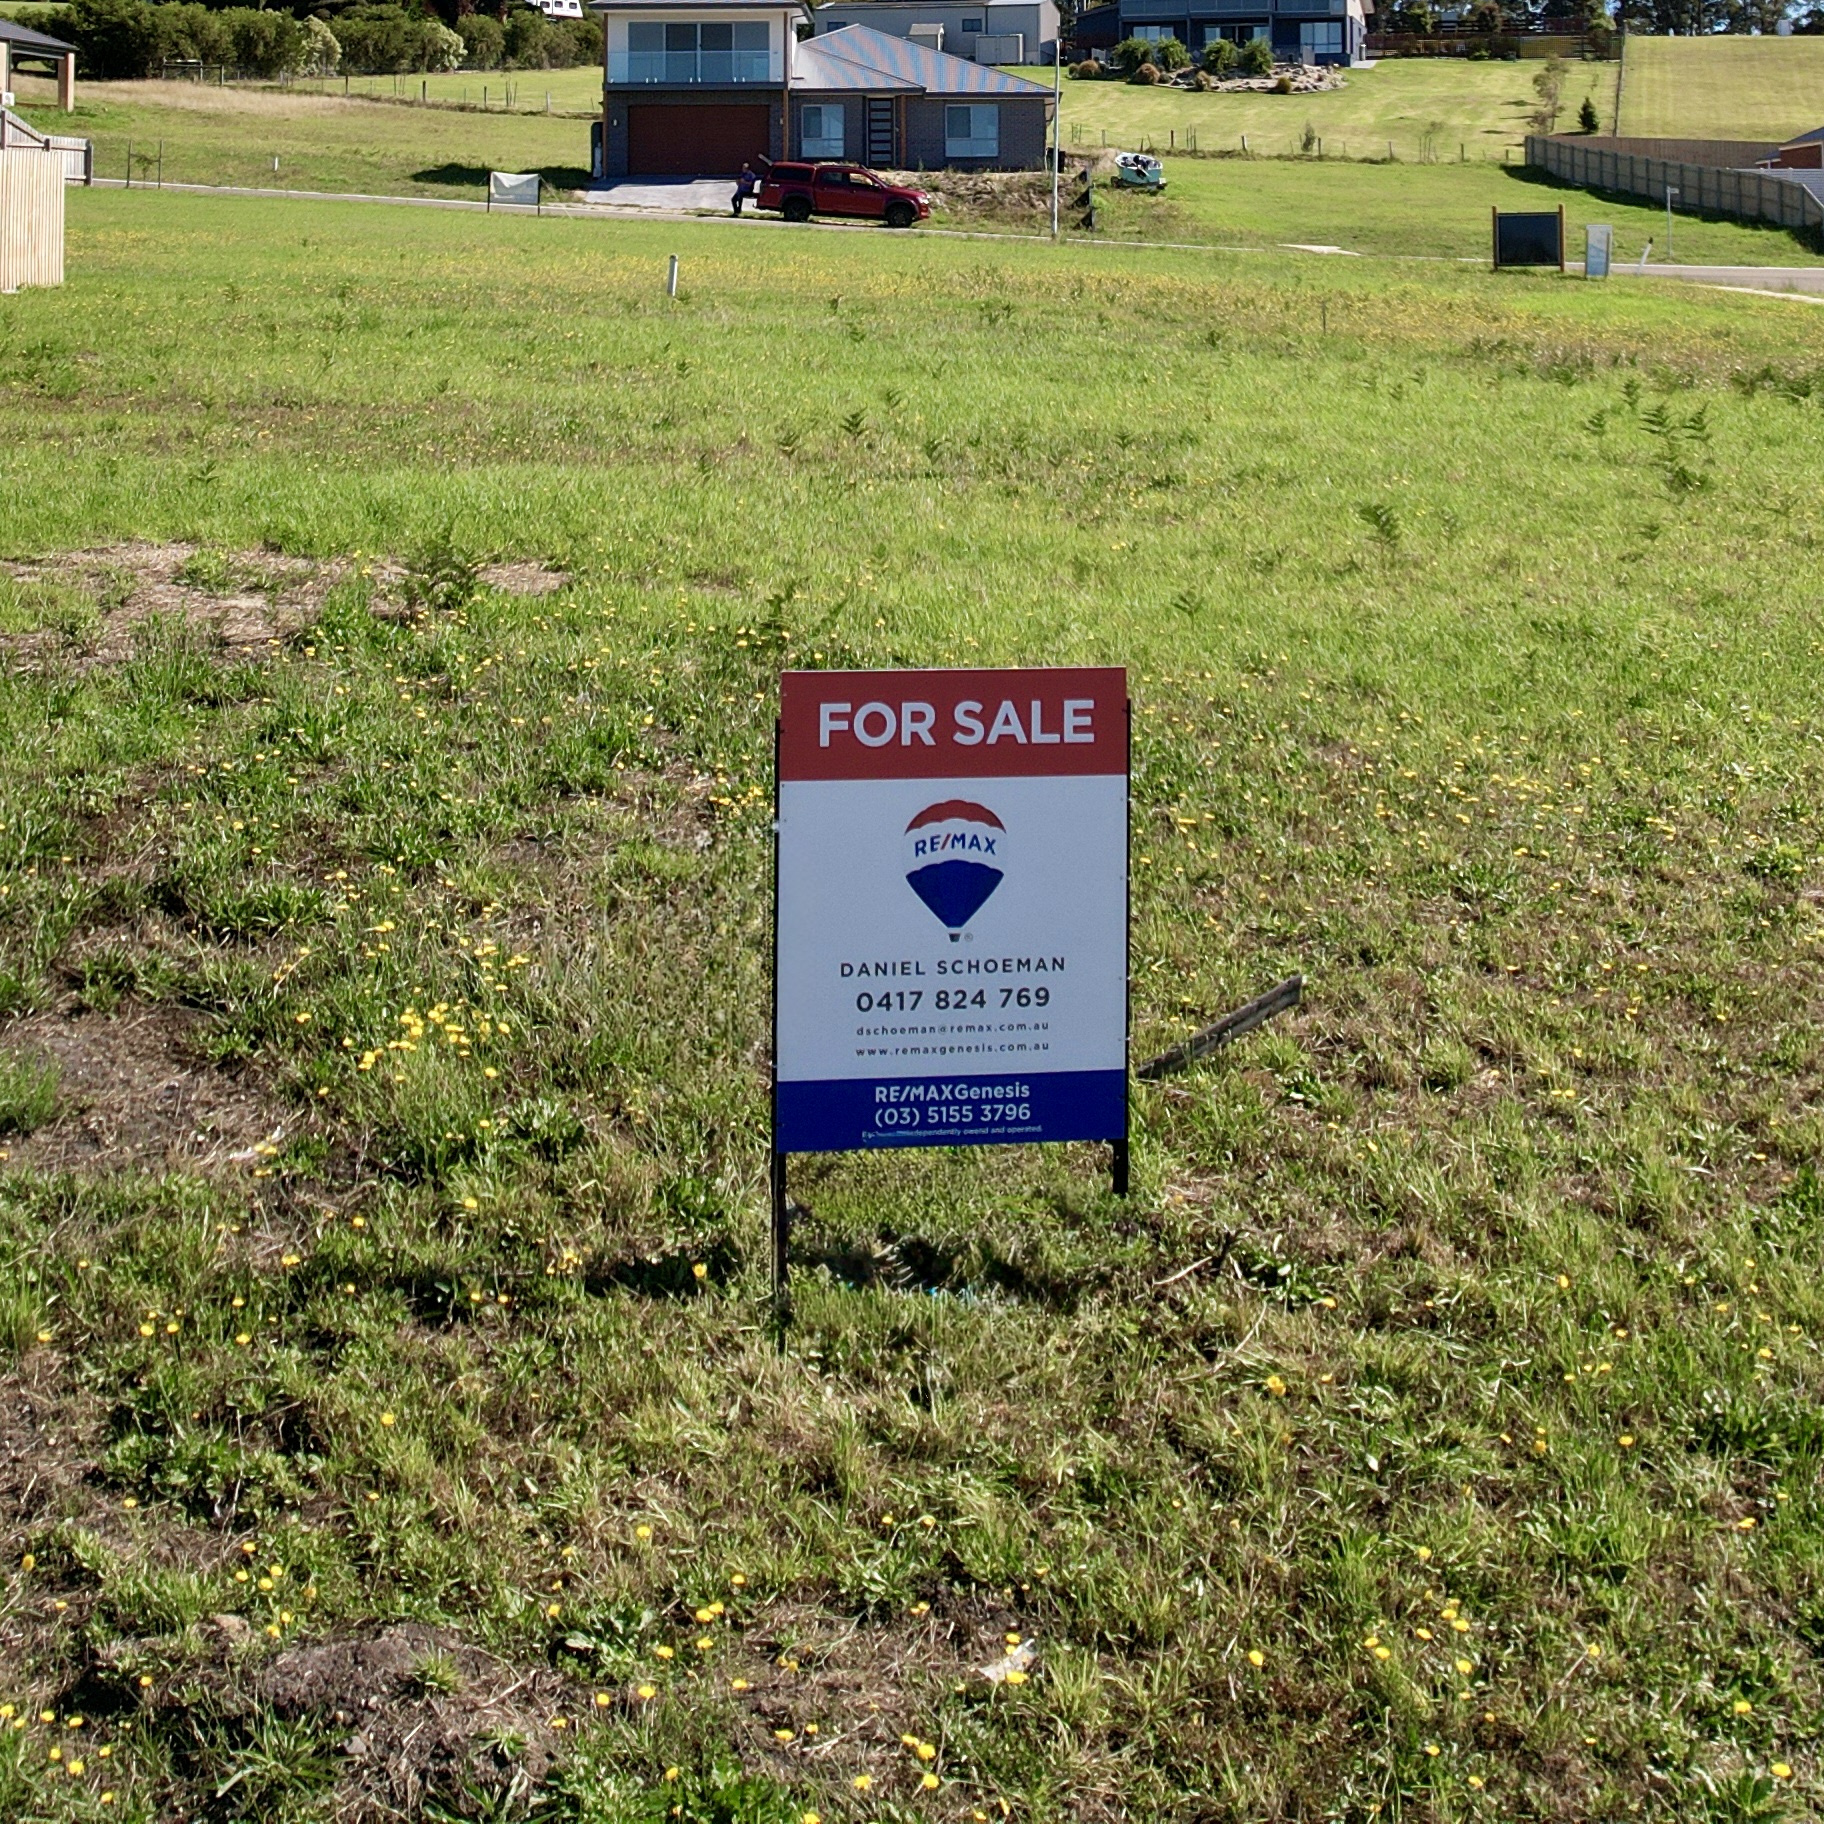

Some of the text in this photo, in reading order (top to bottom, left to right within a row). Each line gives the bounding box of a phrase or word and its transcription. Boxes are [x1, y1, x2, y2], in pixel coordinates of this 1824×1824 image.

[819, 699, 1095, 747] FOR SALE
[914, 832, 997, 857] RE/MAX
[840, 957, 1065, 977] DANIEL SCHOEMAN
[856, 986, 1050, 1012] 0417 824 769
[856, 1022, 1049, 1036] dschoeman@remax.com.au
[855, 1042, 1049, 1057] www.remaxgenesis.com.au
[875, 1103, 1031, 1128] (03) 5155 3796
[991, 1125, 1005, 1133] and
